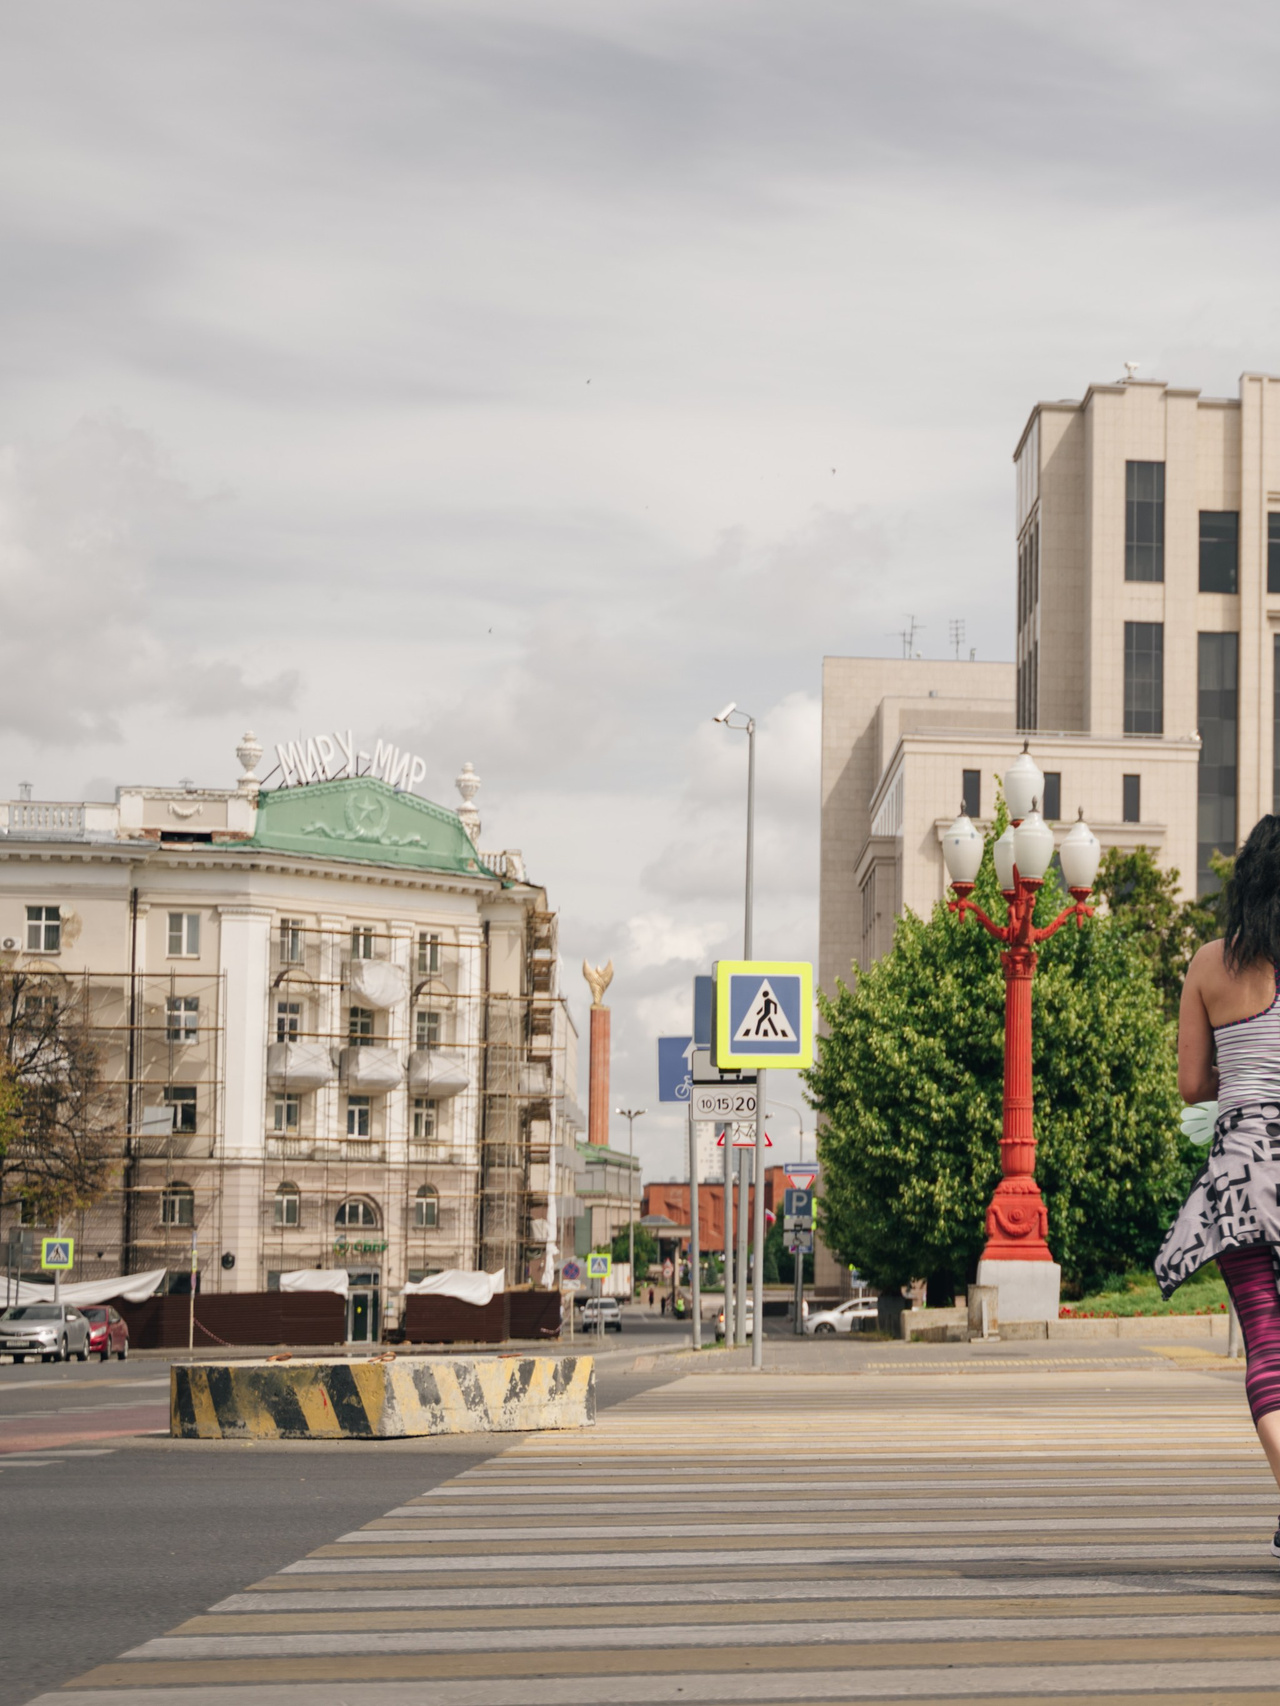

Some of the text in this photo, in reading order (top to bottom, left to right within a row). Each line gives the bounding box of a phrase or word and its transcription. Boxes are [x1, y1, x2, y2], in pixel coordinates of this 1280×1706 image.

[701, 1096, 757, 1111] 10 15 20
[791, 1191, 808, 1214] P
